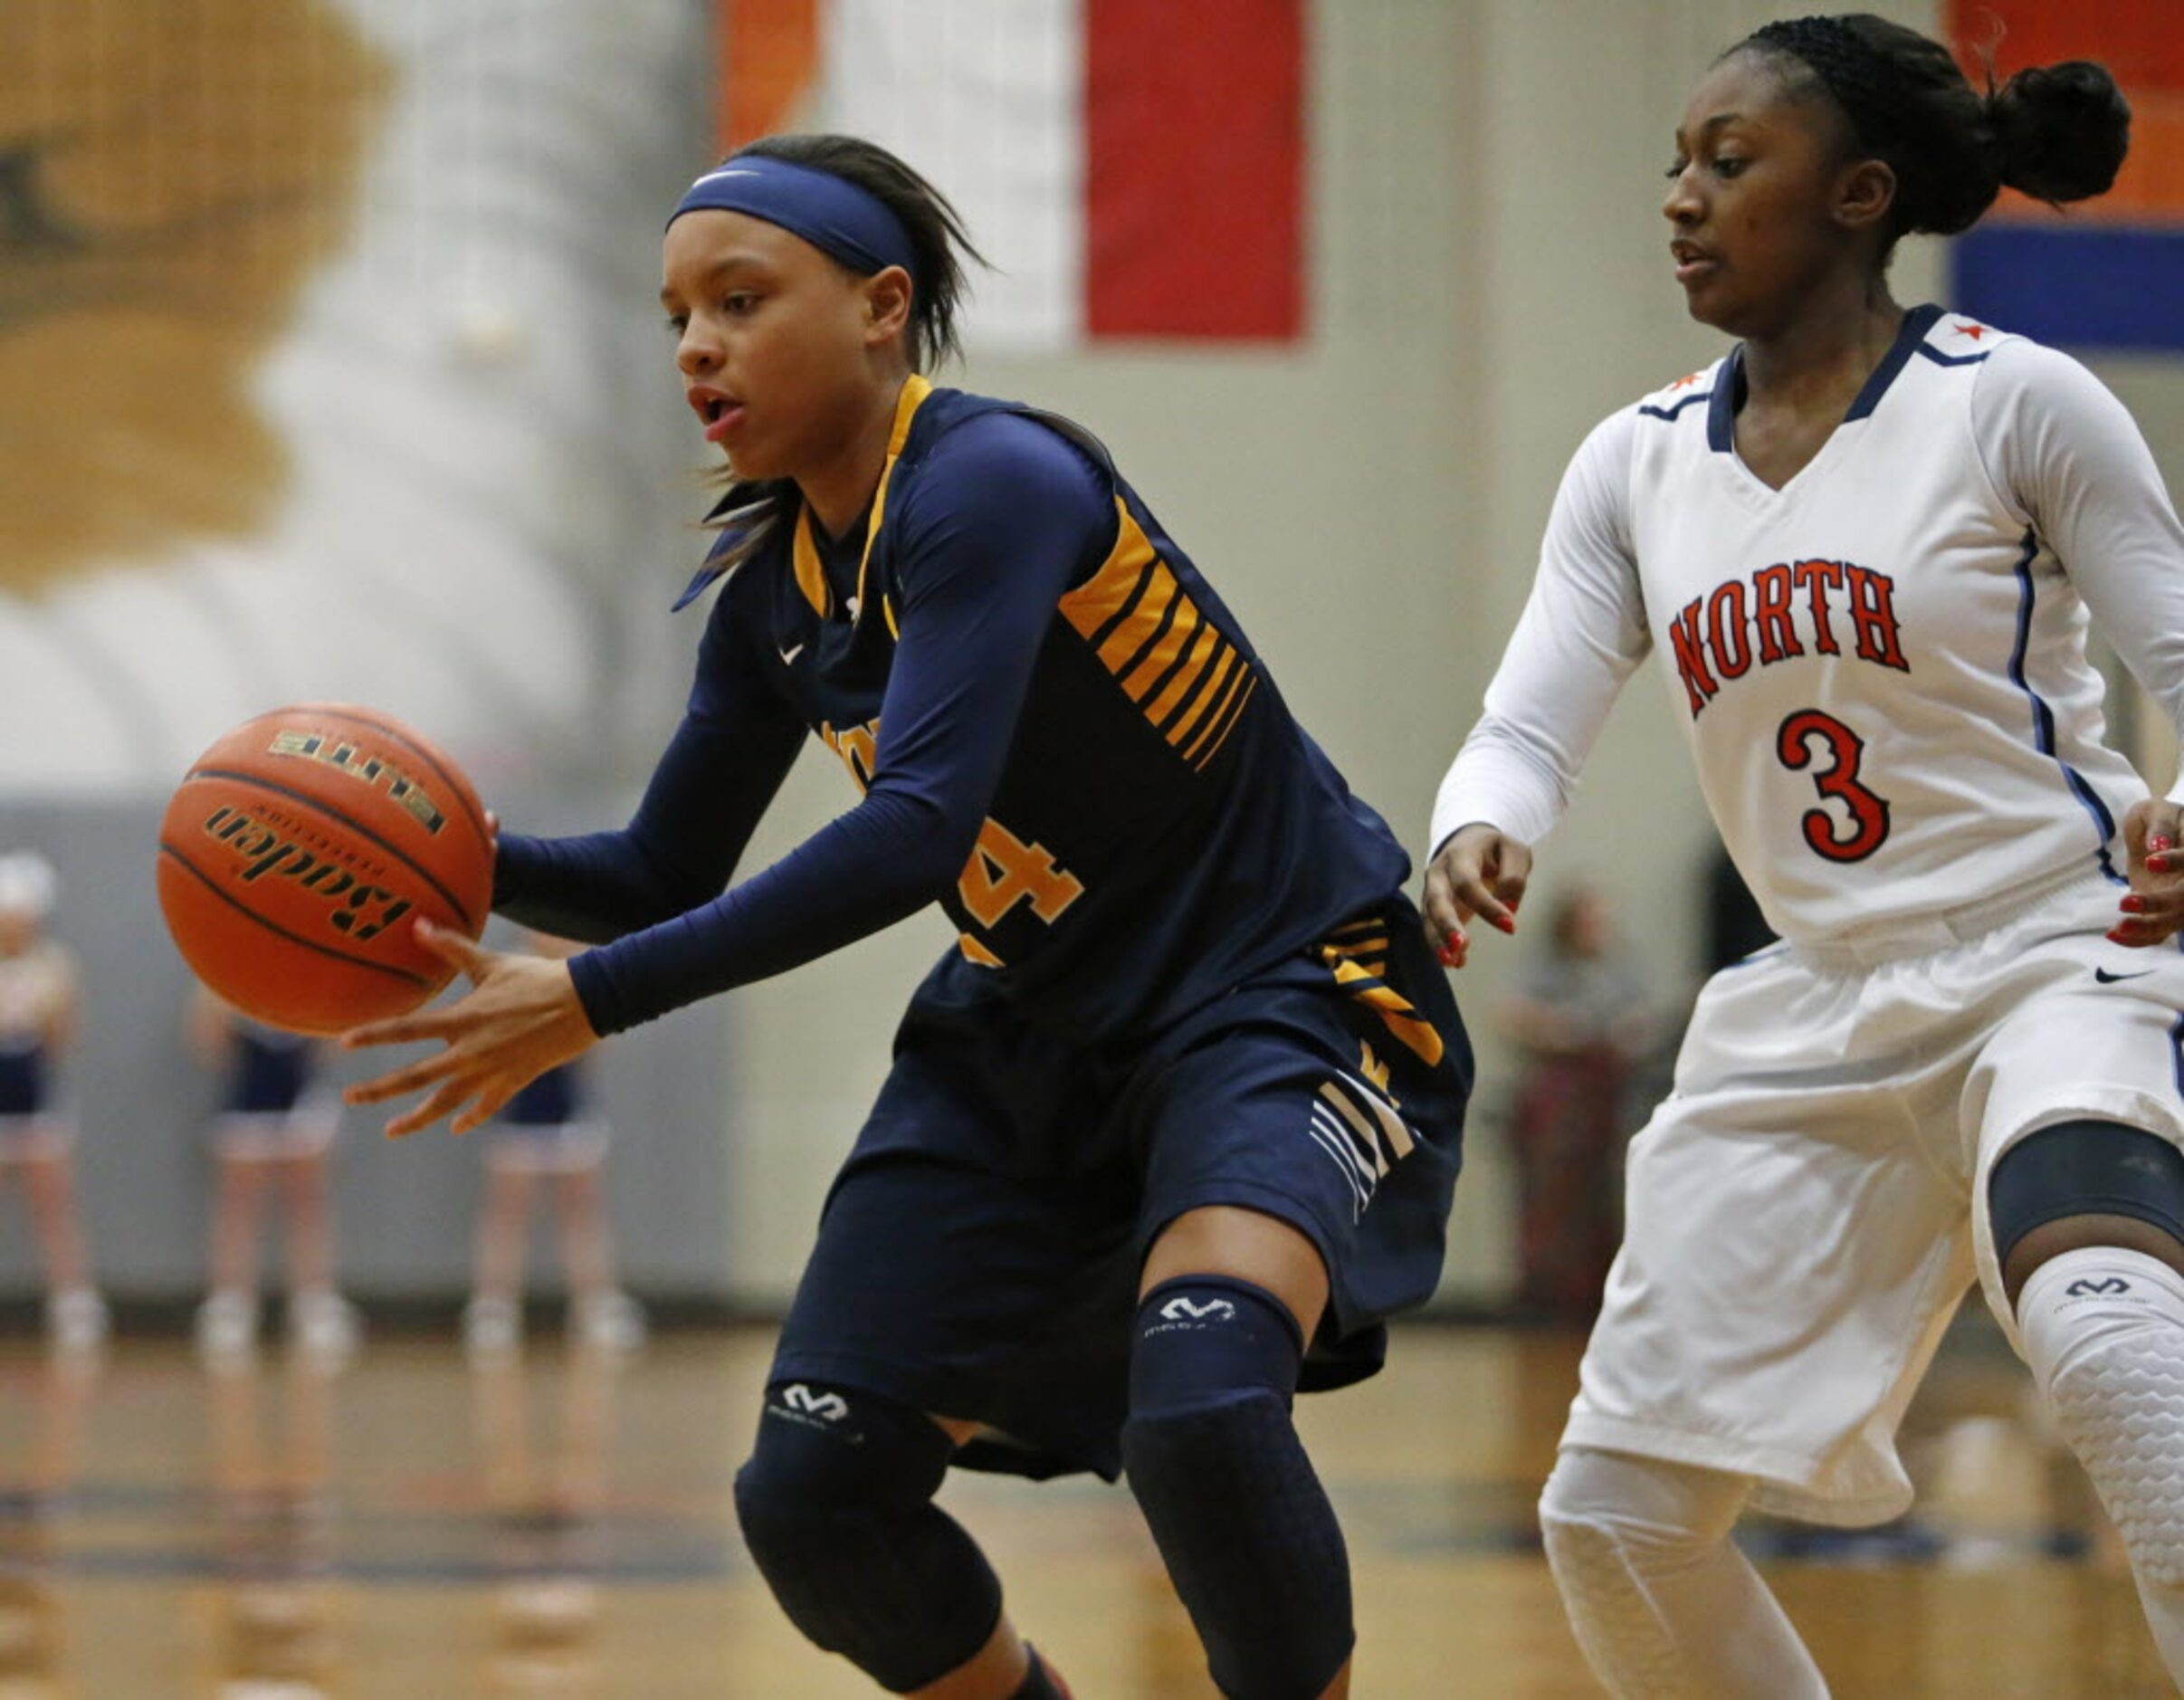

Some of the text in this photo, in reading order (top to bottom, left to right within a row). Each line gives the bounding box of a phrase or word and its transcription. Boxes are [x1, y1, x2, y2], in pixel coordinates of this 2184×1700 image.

[1669, 559, 1911, 721] NORTH
[269, 730, 447, 836] ELITE
[1776, 708, 1891, 864] 3
[205, 805, 413, 941] Baden
[958, 816, 1086, 968] 4
